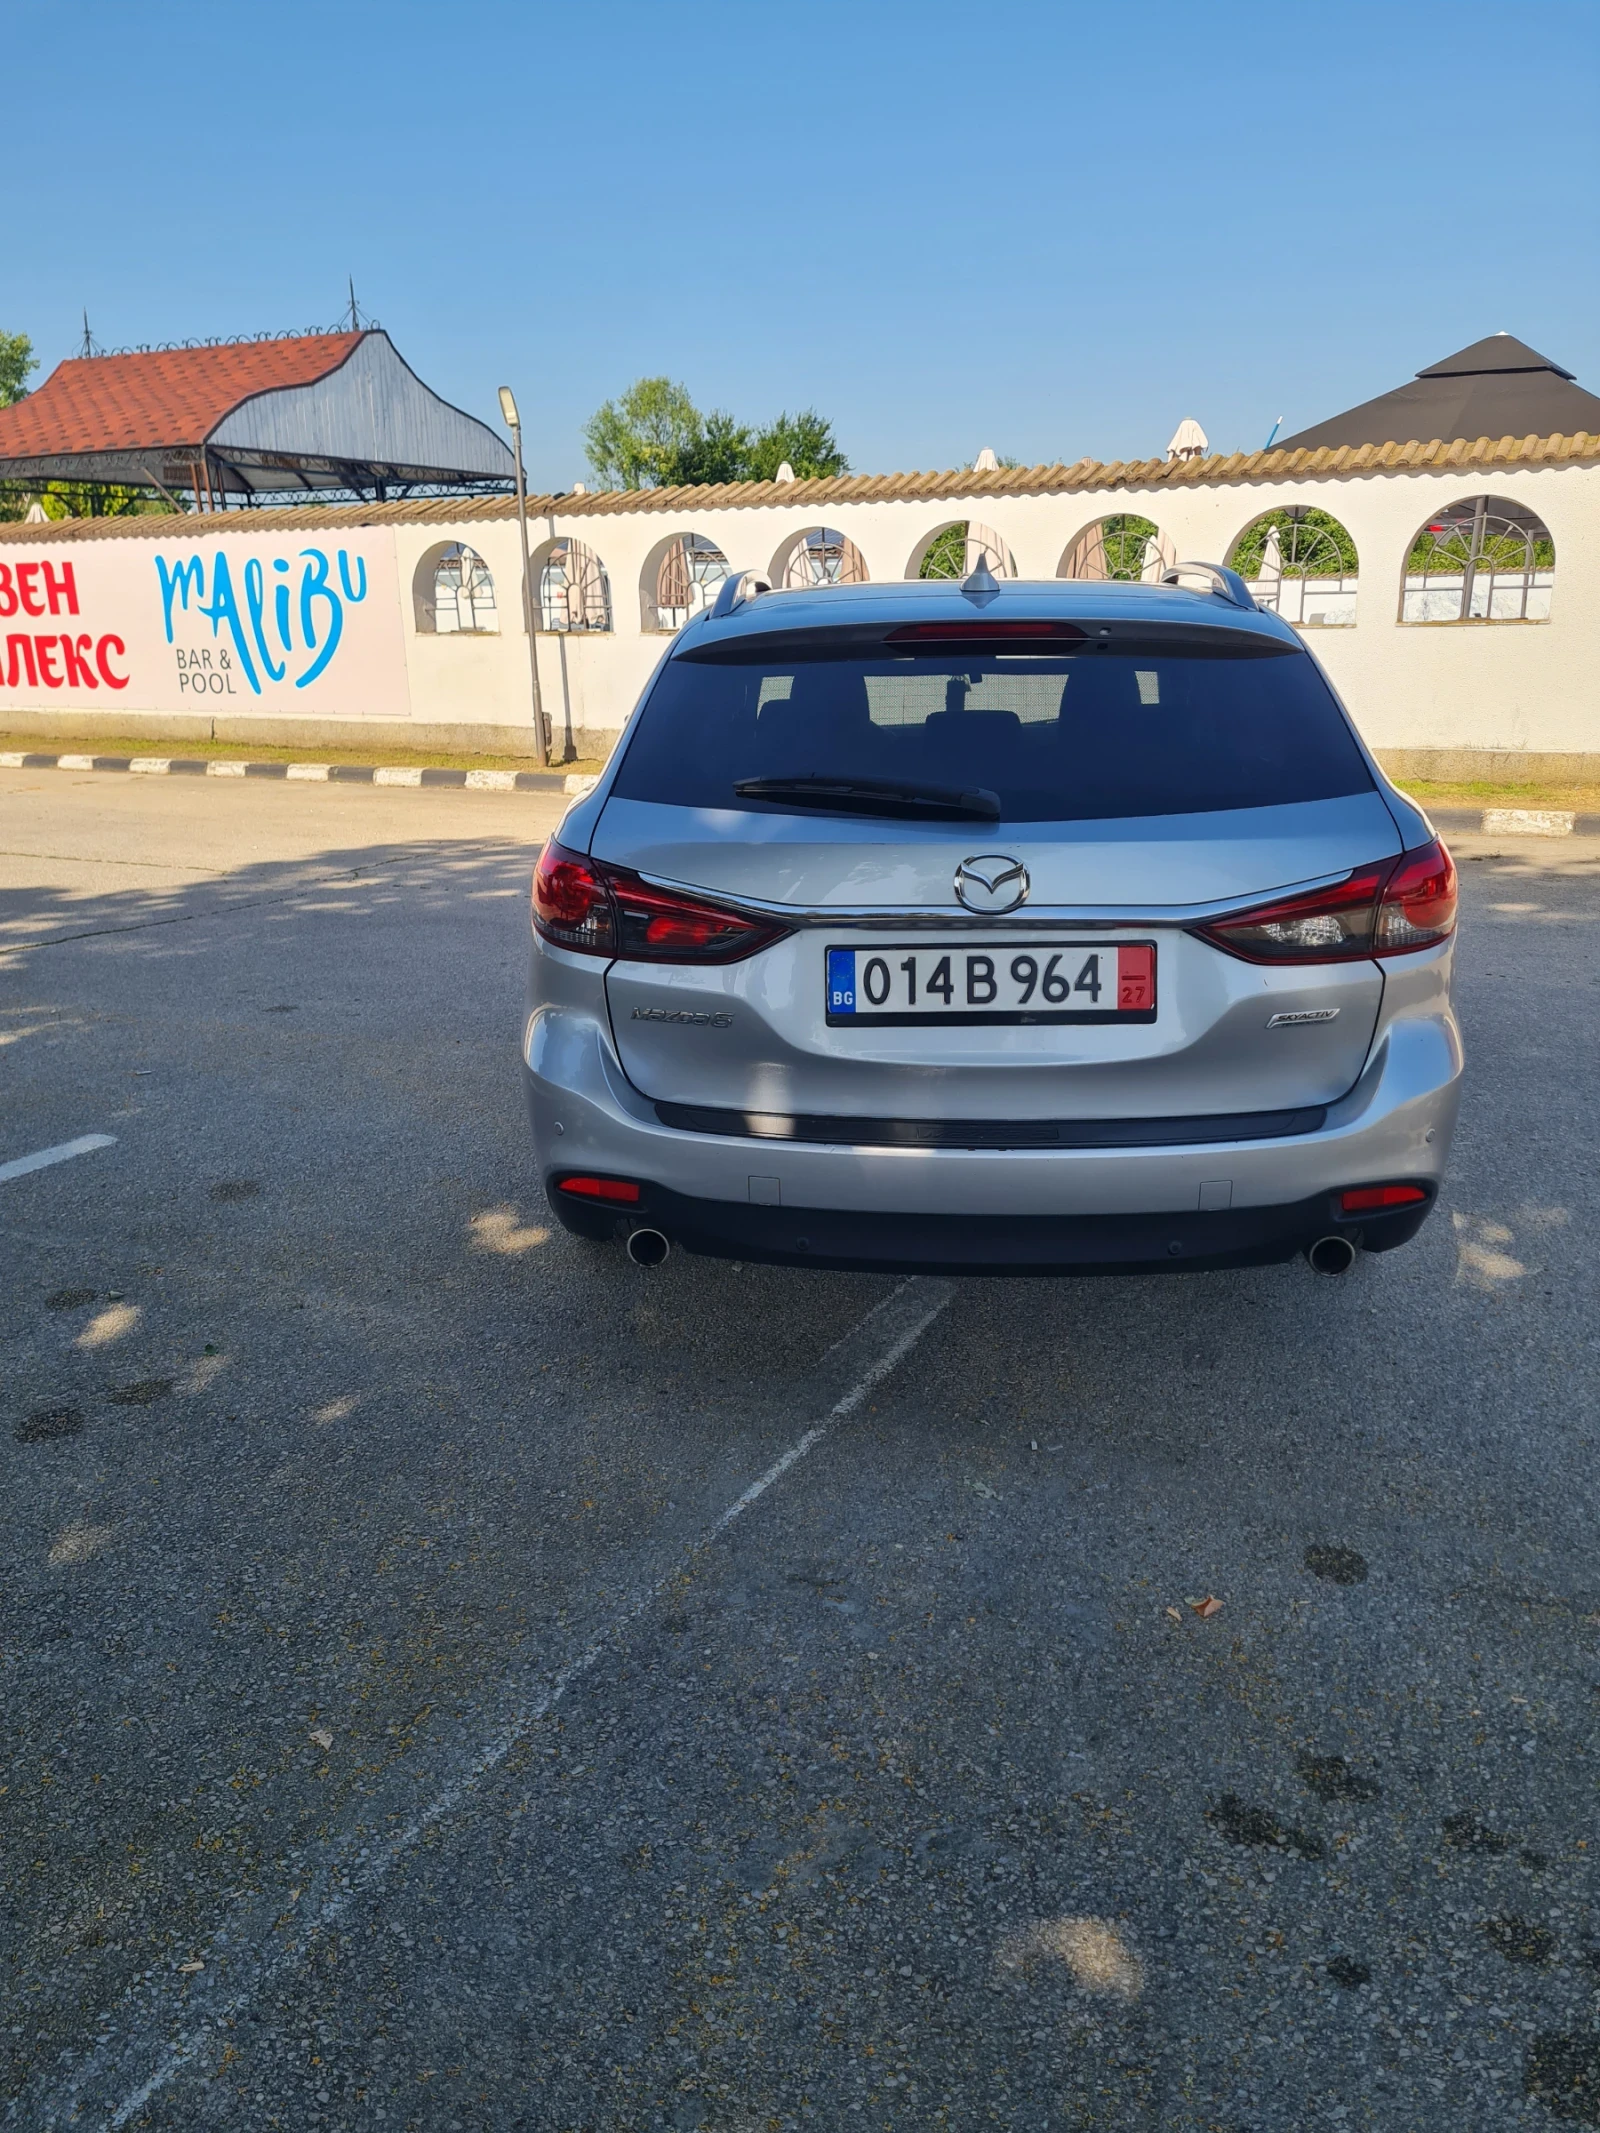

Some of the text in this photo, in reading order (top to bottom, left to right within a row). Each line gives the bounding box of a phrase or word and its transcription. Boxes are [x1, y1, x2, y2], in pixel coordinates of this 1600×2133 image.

[0, 633, 130, 689] ЛЕКС
[176, 648, 232, 670] BAR &
[179, 672, 237, 694] POOL
[833, 991, 853, 1006] BG
[1121, 985, 1146, 1004] 27
[1278, 1010, 1334, 1021] SKYACTIV
